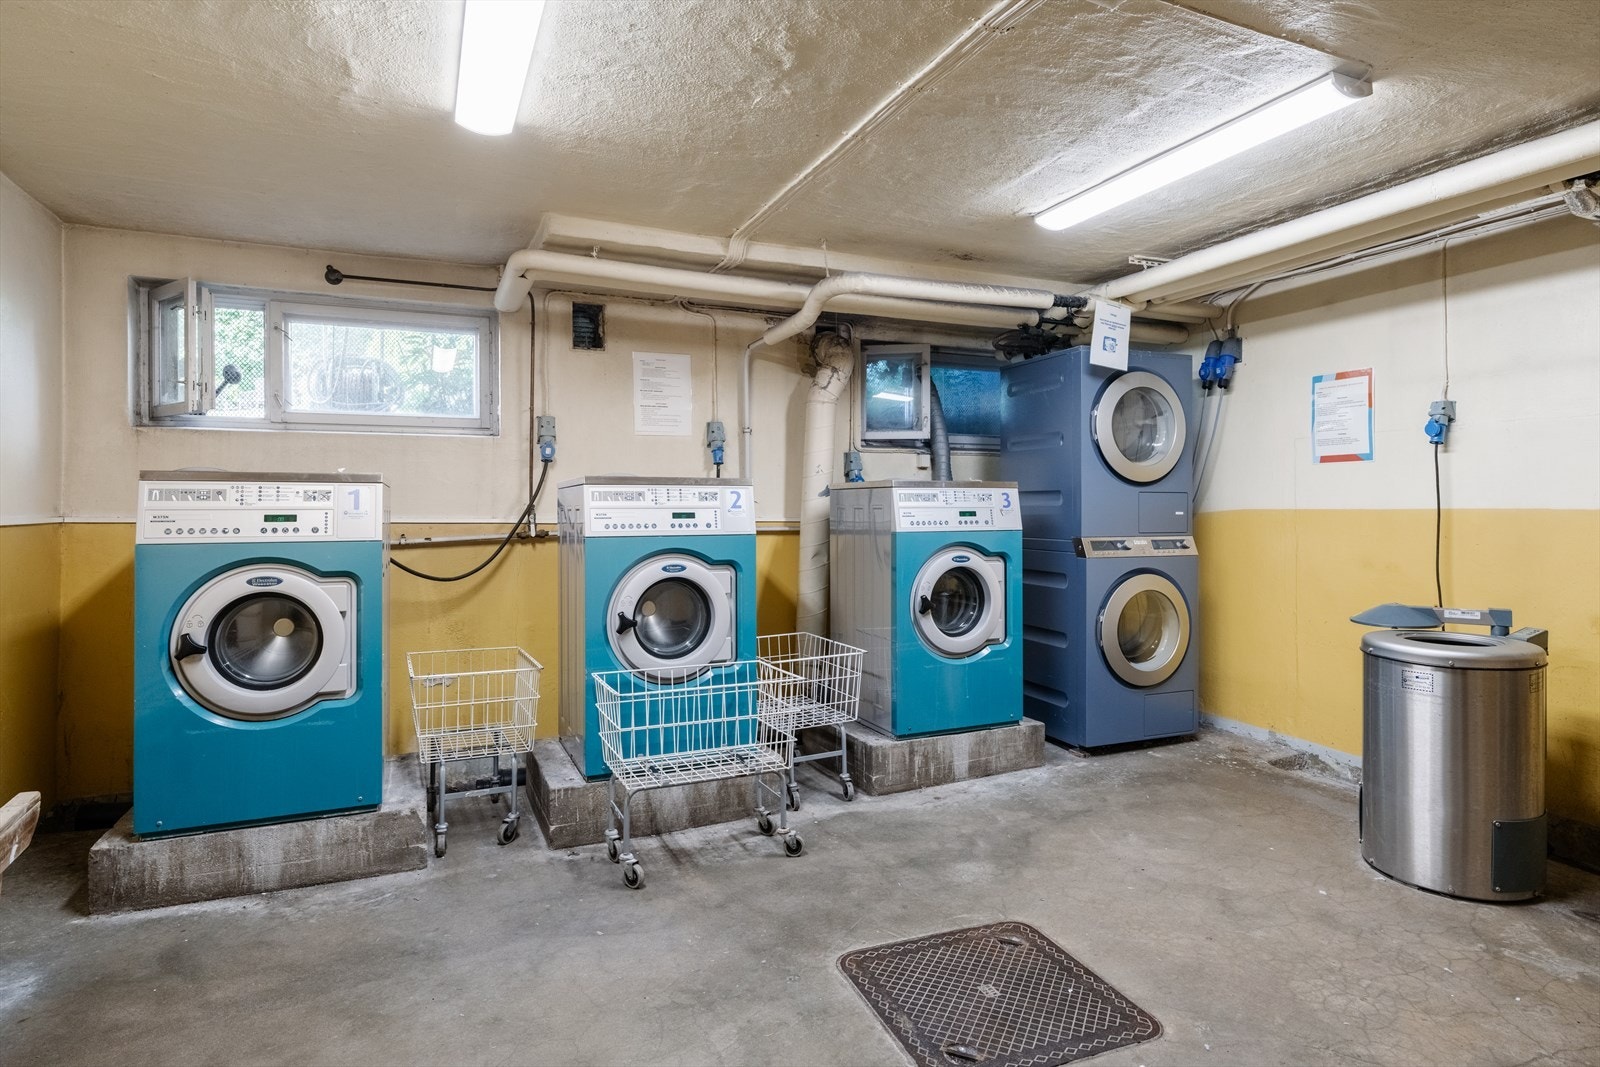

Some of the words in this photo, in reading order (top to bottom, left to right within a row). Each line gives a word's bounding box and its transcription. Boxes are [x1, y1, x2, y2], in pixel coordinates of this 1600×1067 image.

[347, 489, 360, 510] 1
[730, 491, 742, 509] 2
[1001, 492, 1011, 508] 3
